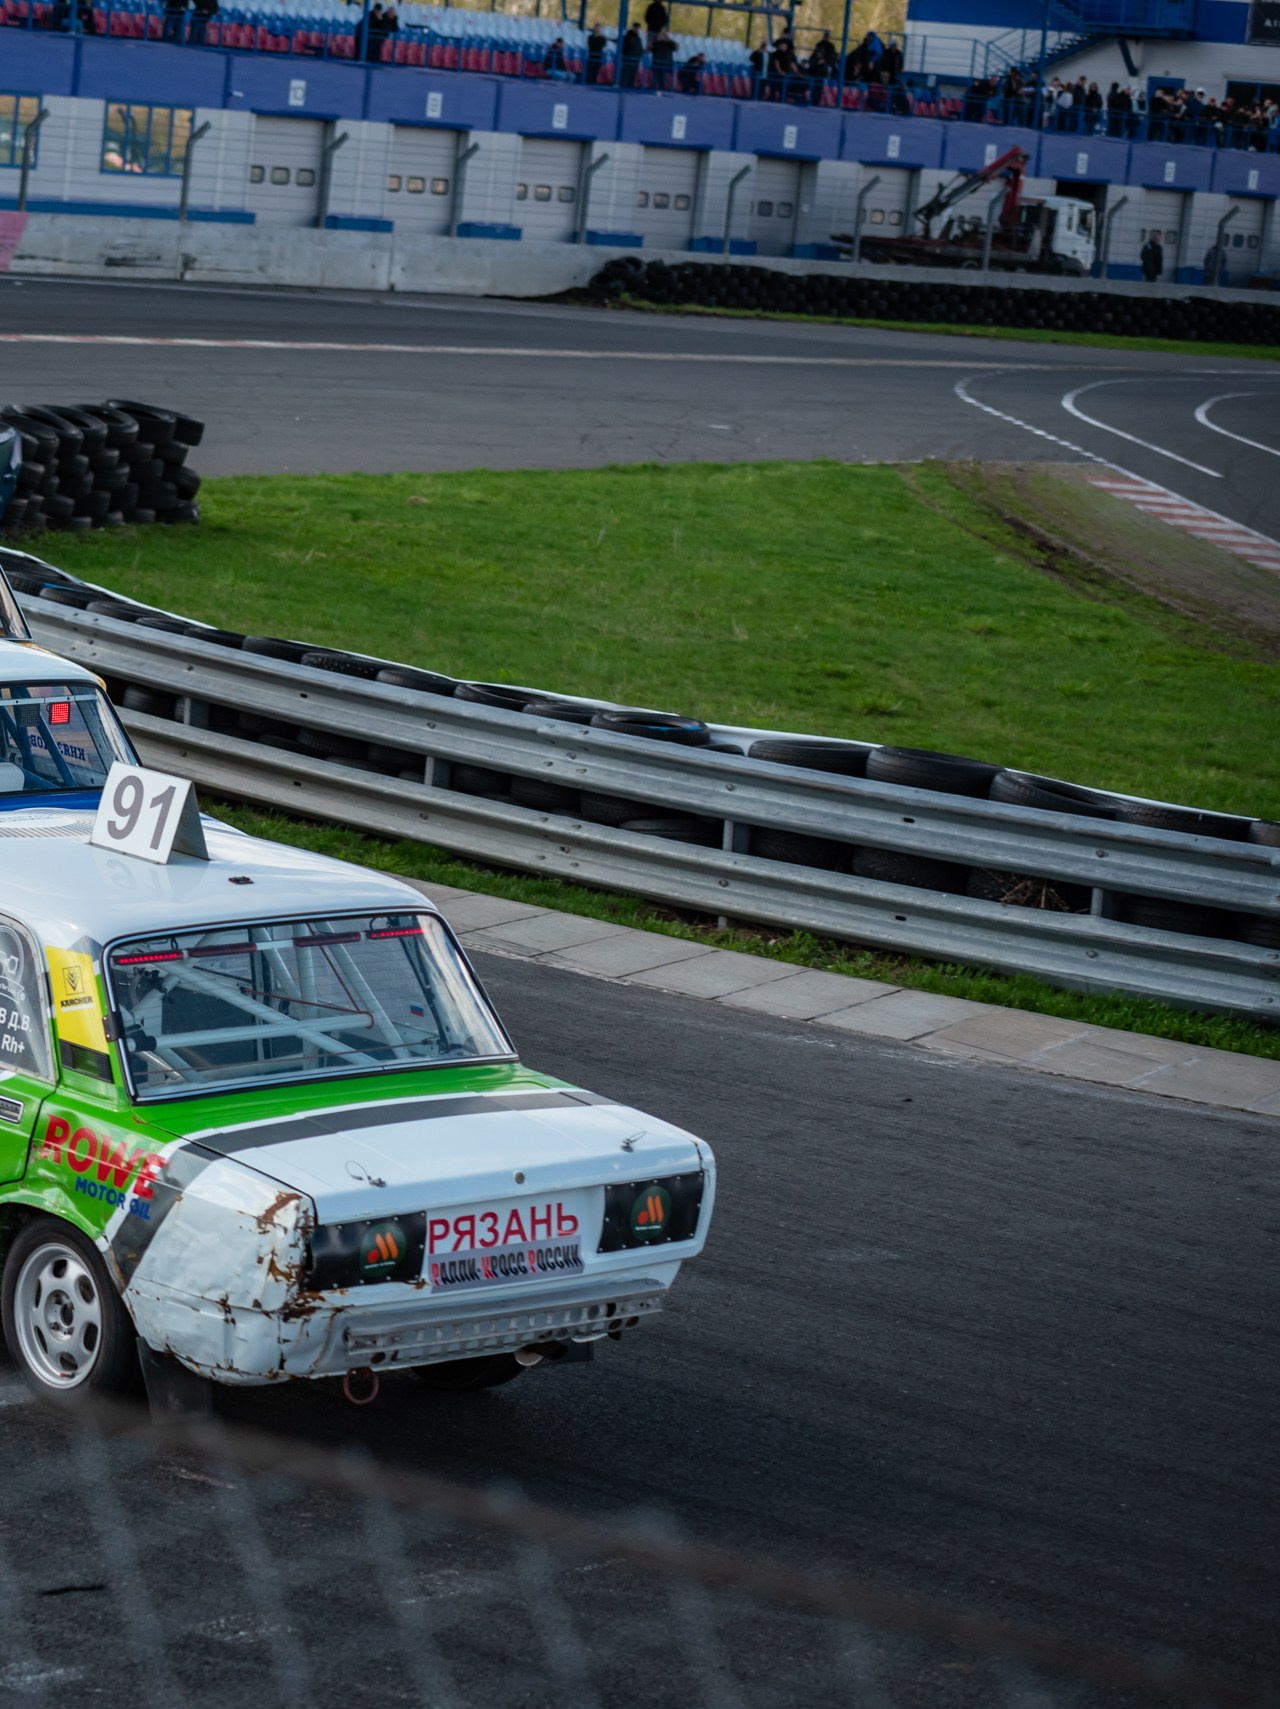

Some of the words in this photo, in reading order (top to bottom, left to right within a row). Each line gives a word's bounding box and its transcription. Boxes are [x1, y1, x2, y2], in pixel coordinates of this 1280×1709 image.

[106, 775, 177, 851] 91
[1, 1033, 25, 1054] Rh+
[7, 1010, 32, 1033] Д.В.
[39, 1113, 167, 1201] ROWE
[75, 1175, 127, 1210] MOTOR
[129, 1197, 151, 1220] OIL
[429, 1202, 579, 1255] РЯЗАНЬ
[528, 1243, 583, 1274] РОССИИ
